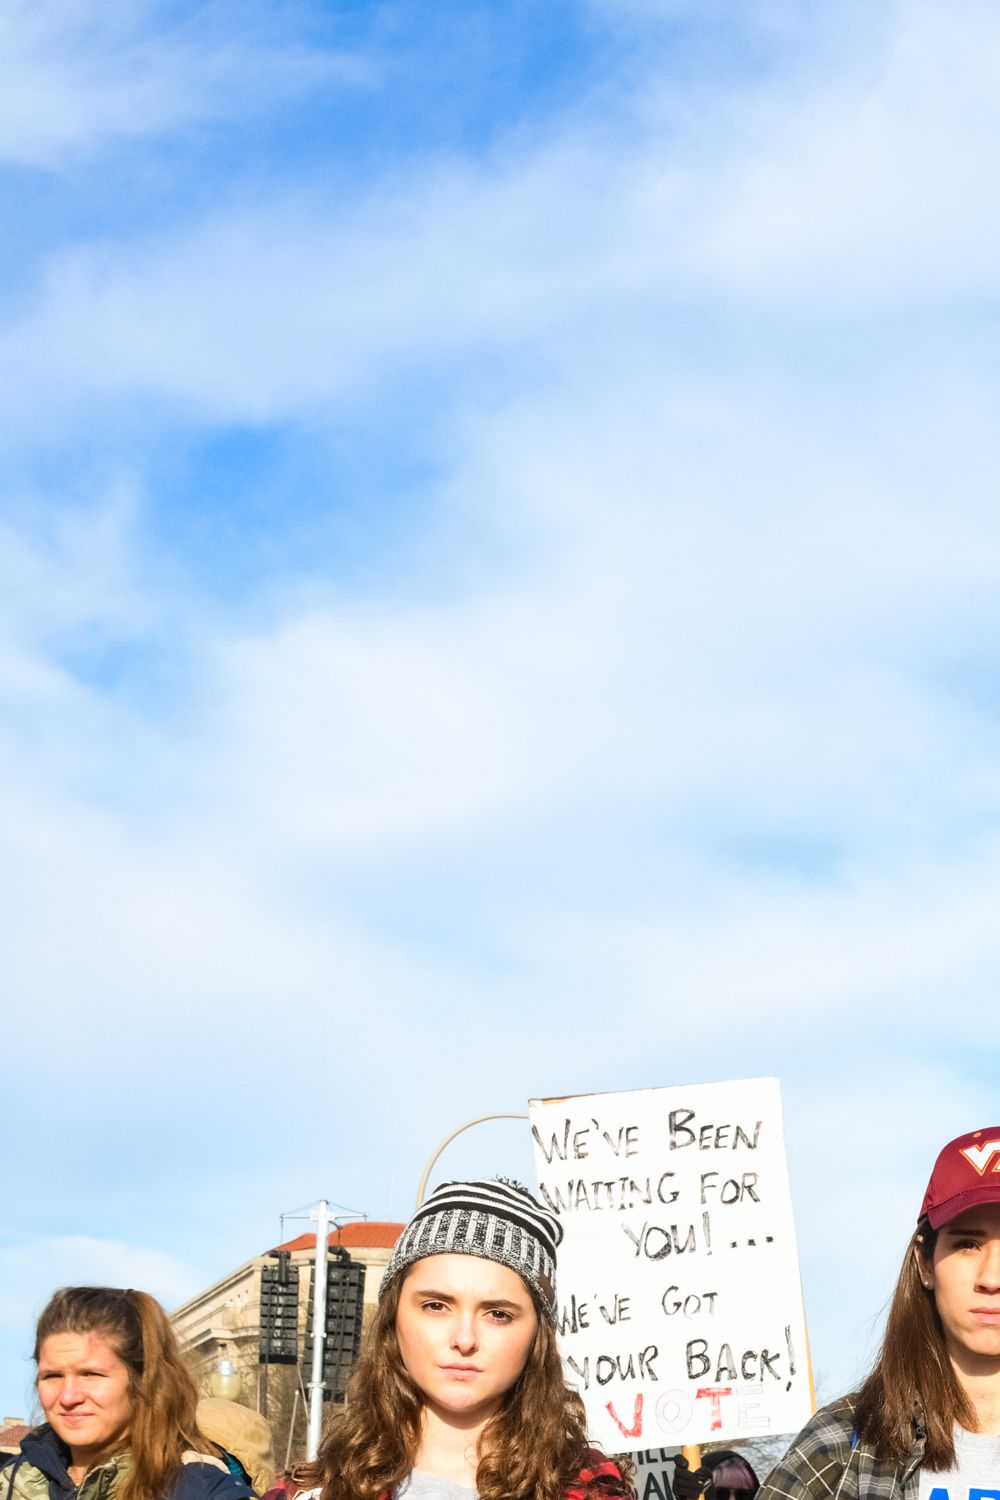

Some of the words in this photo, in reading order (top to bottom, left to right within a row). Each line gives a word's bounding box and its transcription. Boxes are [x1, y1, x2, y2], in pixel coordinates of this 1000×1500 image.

[531, 1118, 639, 1164] WE'VE
[668, 1108, 762, 1151] BEEN
[540, 1171, 680, 1215] WAITING
[700, 1171, 761, 1205] FOR
[556, 1294, 632, 1337] WE'VE
[662, 1285, 718, 1320] GOT
[566, 1345, 659, 1391] YOUR
[686, 1325, 796, 1392] BACK!
[605, 1384, 771, 1438] VOTE
